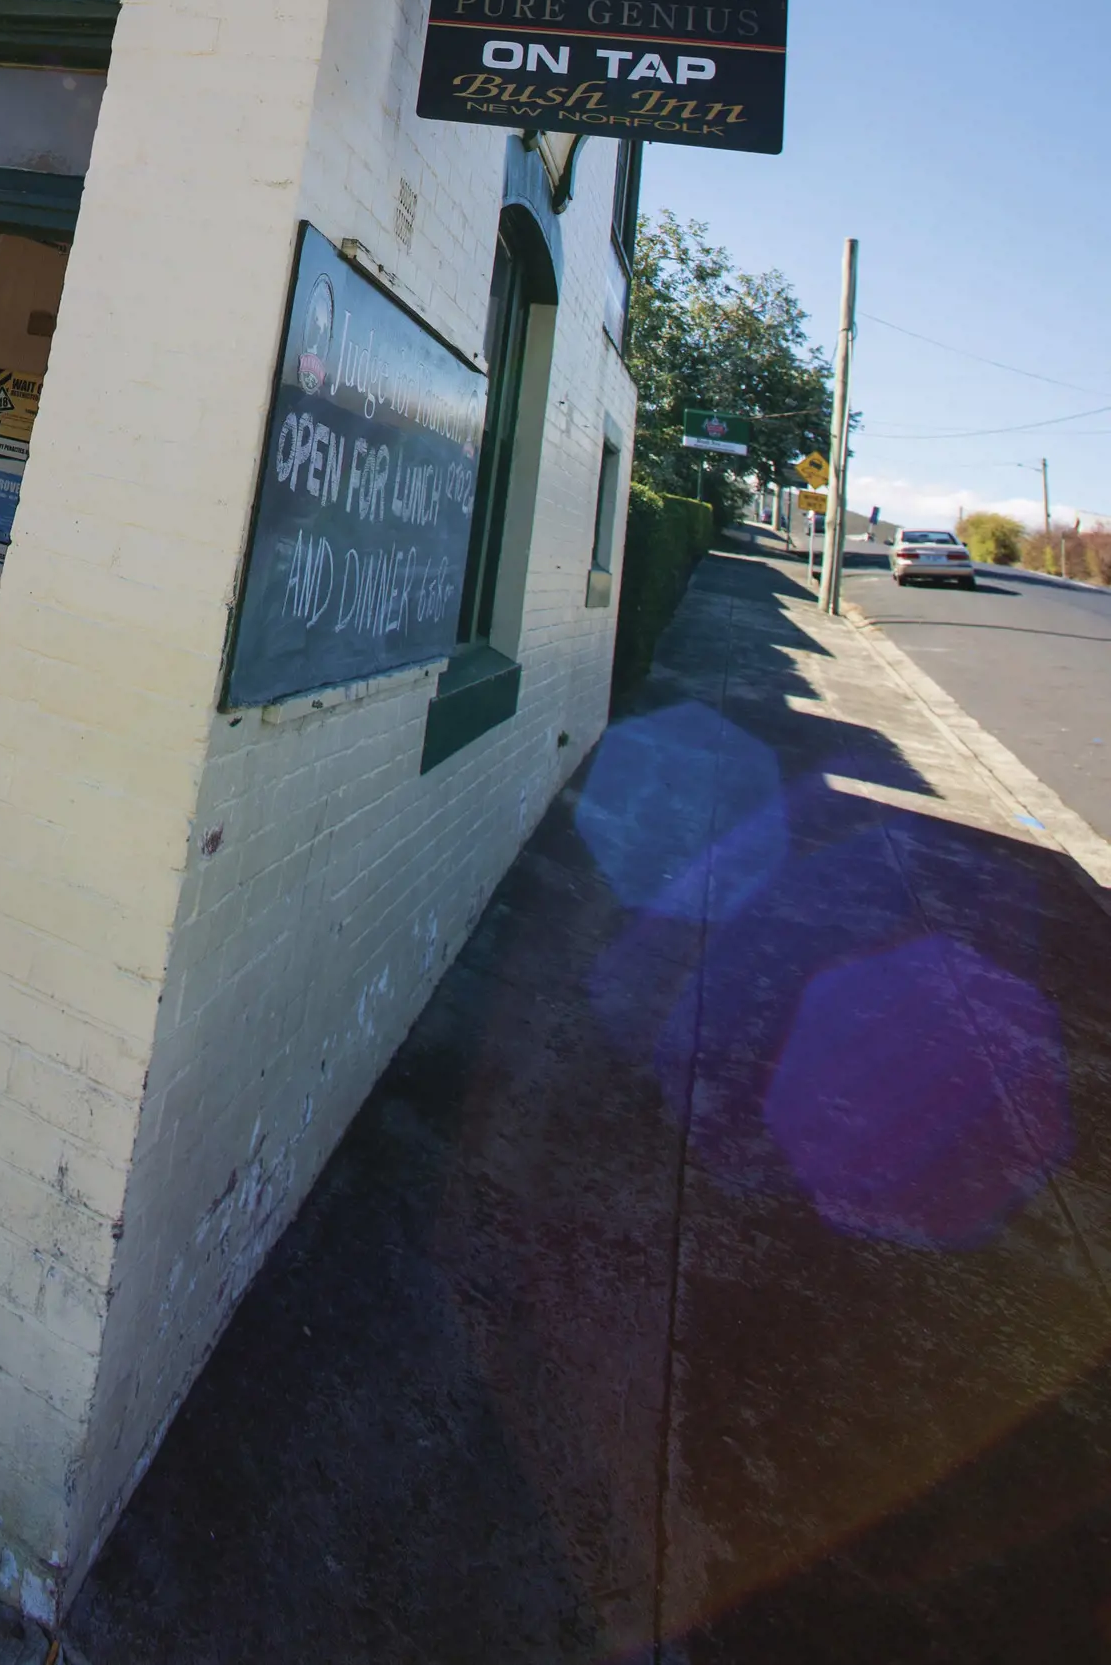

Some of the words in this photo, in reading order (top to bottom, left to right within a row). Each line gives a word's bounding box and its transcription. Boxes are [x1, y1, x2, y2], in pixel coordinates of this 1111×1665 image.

[482, 40, 570, 75] ON
[596, 49, 716, 85] TAP
[452, 73, 608, 110] Bush
[629, 90, 748, 124] Inn
[466, 101, 542, 118] NEW
[558, 110, 726, 137] NORFOLK
[12, 378, 37, 393] WAIT
[331, 310, 390, 419] Judge
[276, 412, 346, 507] OPEN
[346, 437, 390, 523] FOR
[392, 445, 442, 526] LUNCH
[282, 529, 334, 629] AND
[335, 541, 417, 638] DINNER
